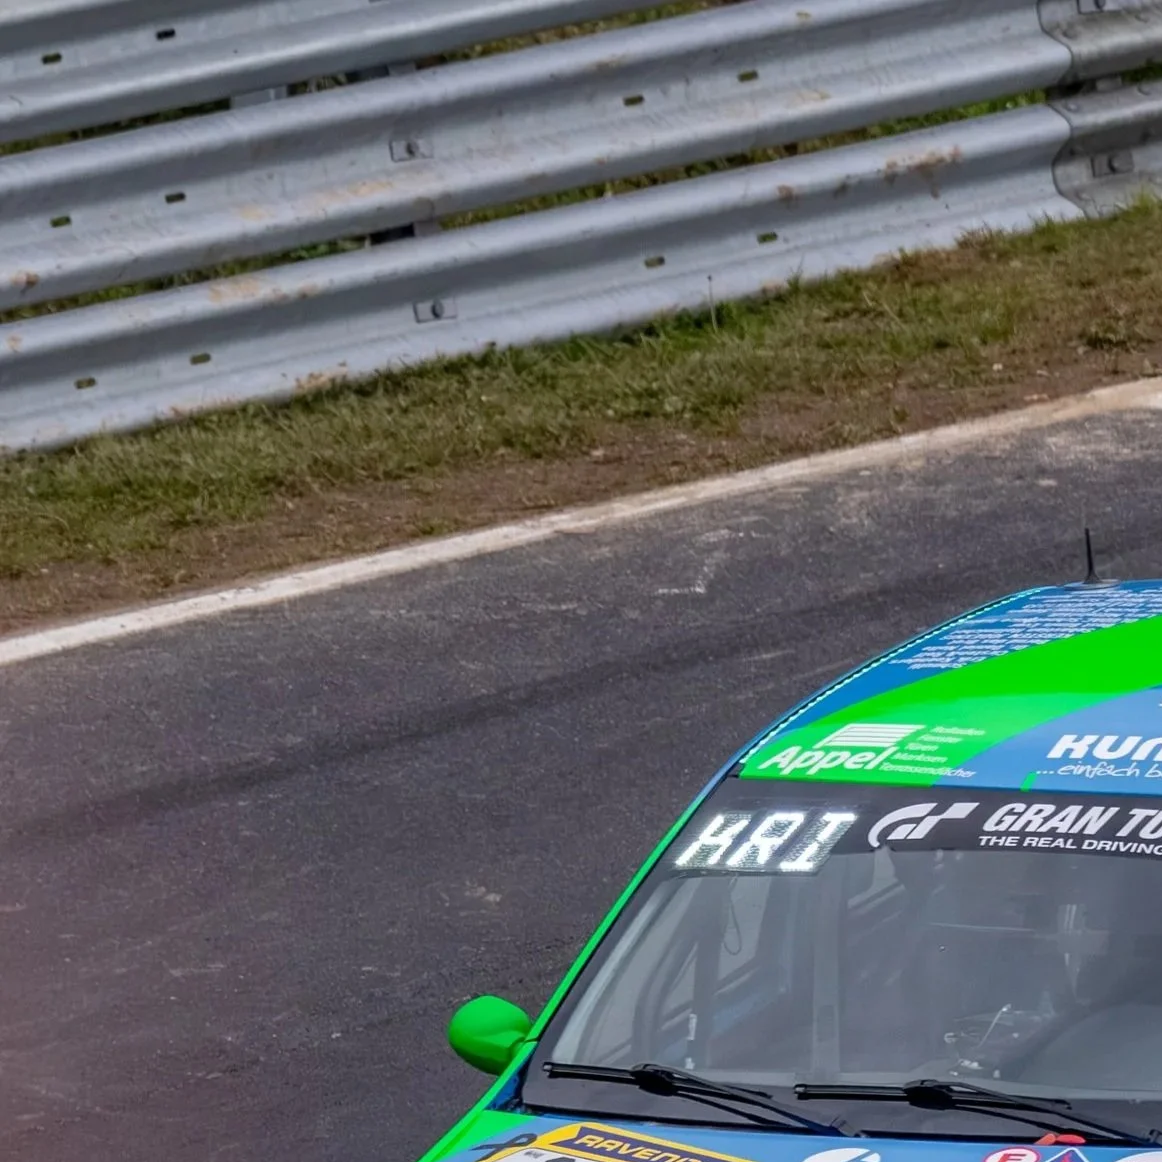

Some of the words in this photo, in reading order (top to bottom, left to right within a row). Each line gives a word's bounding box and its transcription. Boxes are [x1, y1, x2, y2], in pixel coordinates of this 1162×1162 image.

[758, 745, 900, 775] Appel
[983, 803, 1120, 836] GRAN
[979, 835, 1020, 846] THE
[1023, 836, 1077, 849] REAL
